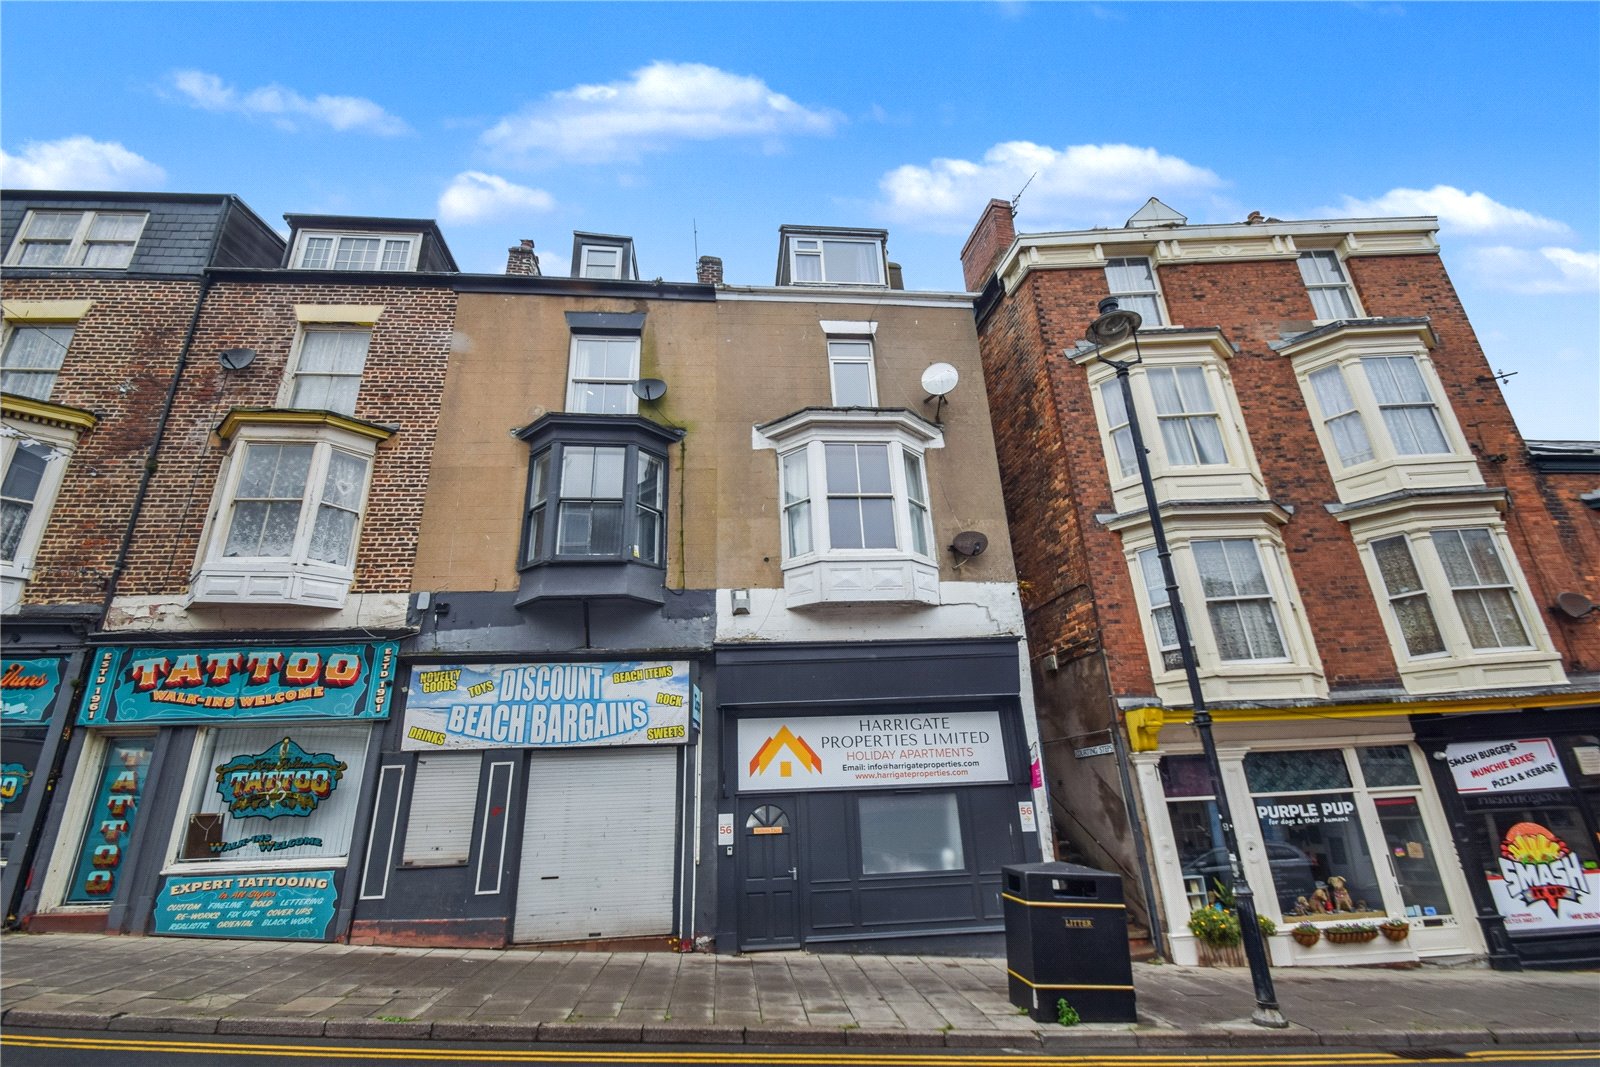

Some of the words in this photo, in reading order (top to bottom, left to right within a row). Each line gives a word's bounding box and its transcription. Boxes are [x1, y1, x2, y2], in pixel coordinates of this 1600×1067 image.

[96, 652, 112, 684] ESTD
[131, 651, 362, 690] TATTOO
[380, 648, 392, 678] ESTD
[419, 669, 462, 684] NOVELTY
[500, 665, 603, 702] DISCOUNT
[613, 668, 644, 684] BEACH
[645, 666, 673, 680] ITEMS
[422, 680, 458, 693] GOODS
[467, 680, 494, 698] TOYS
[88, 687, 101, 720] 1961
[152, 689, 236, 708] WALK-INS
[239, 686, 324, 708] WELCOME
[375, 681, 386, 713] 1961
[656, 692, 682, 707] ROCK
[447, 704, 527, 744] BEACH
[530, 700, 648, 744] BARGAINS
[859, 717, 950, 732] HARRIGATE
[408, 726, 446, 746] DRINKS
[647, 725, 685, 740] SWEETS
[822, 733, 918, 748] PROPERTIES
[924, 731, 989, 745] LIMITED
[846, 750, 896, 761] HOLIDAY
[900, 748, 974, 758] APARTMENTS
[1449, 754, 1478, 768] SMASH
[1478, 743, 1517, 760] BURGERS
[842, 763, 866, 771] Email:
[868, 760, 980, 772] info@harrigateproperties.com
[855, 769, 968, 780] www.harrigateproperties.com
[1470, 761, 1509, 778] MUNCHIE
[1510, 753, 1536, 768] BOXES
[1518, 773, 1525, 781] &
[1526, 762, 1558, 778] KEBABS
[230, 770, 331, 798] TATTOO
[1020, 807, 1032, 815] 56
[1256, 804, 1318, 818] PURPLE
[1321, 802, 1354, 816] PUP
[85, 748, 144, 895] TATTOO
[720, 826, 732, 834] 56
[1280, 818, 1296, 826] dogs
[208, 834, 272, 852] WALK-INS
[258, 836, 322, 852] WELCOME
[1498, 851, 1591, 899] SMASH
[170, 878, 233, 896] EXPERT
[238, 876, 328, 890] TATTOOING
[166, 903, 202, 912] CUSTOM
[208, 900, 244, 910] FINELINE
[250, 900, 274, 908] BOLD
[280, 898, 324, 906] LETTERING
[175, 912, 221, 921] RE-WORKS
[226, 910, 240, 918] FIX
[242, 910, 260, 918] UPS
[266, 909, 294, 917] COVER
[294, 908, 313, 916] UPS
[168, 922, 210, 931] REALISTIC
[216, 920, 254, 928] ORIENTAL
[261, 918, 288, 927] BLACK
[290, 917, 316, 925] WORK
[1065, 920, 1094, 928] LITTER
